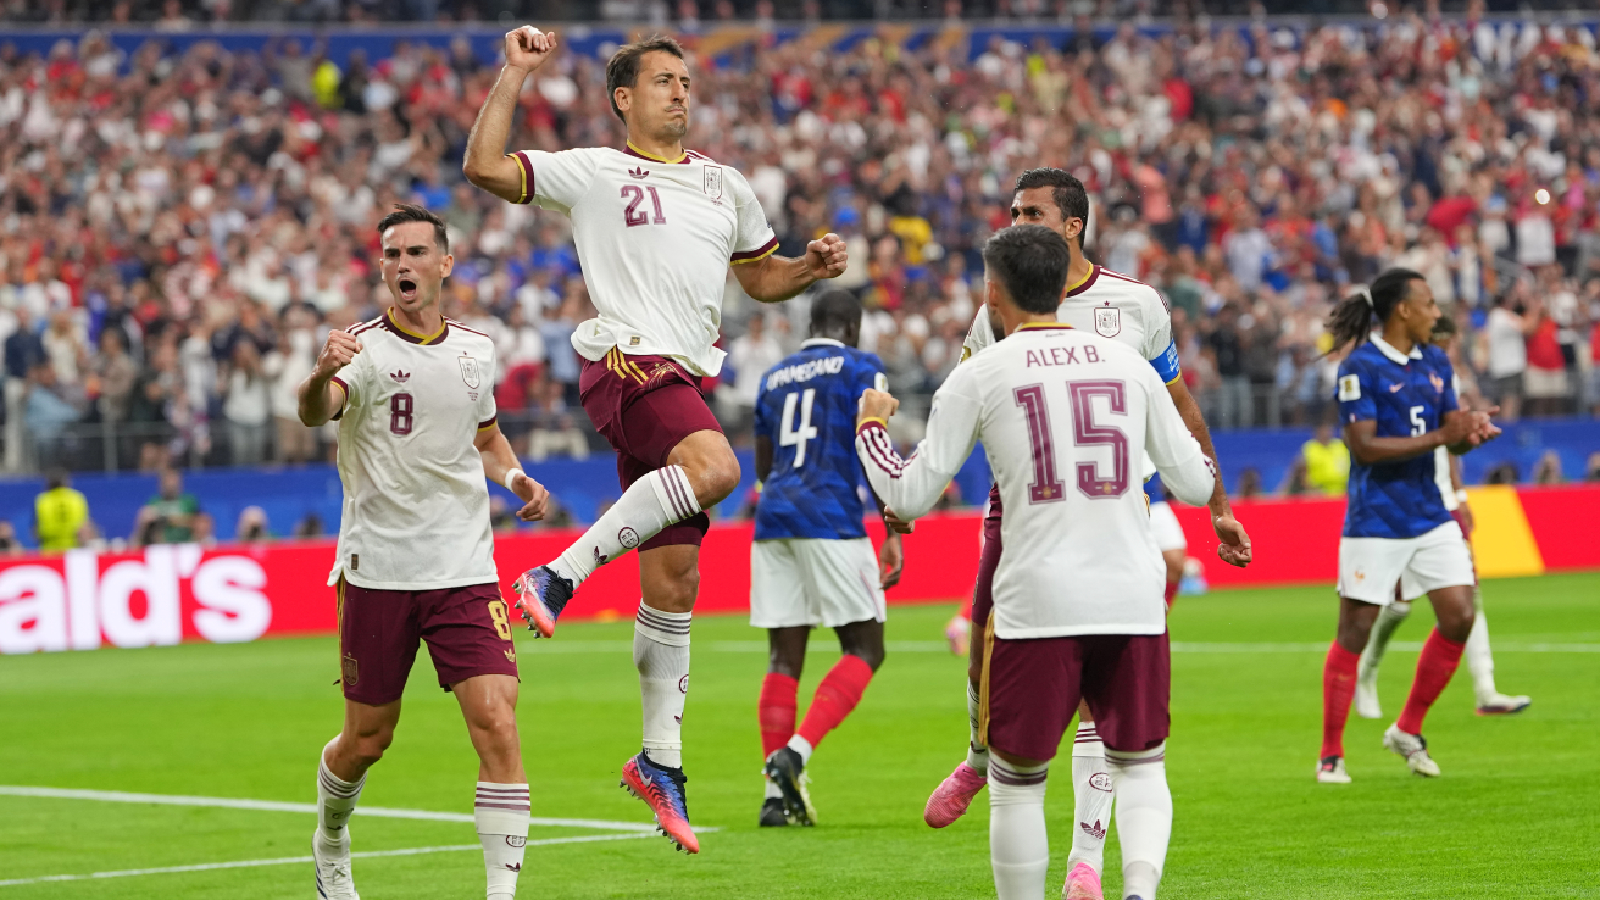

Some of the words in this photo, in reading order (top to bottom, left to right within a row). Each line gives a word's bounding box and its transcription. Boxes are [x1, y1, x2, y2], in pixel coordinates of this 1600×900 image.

[620, 185, 667, 227] 21
[1026, 345, 1080, 367] ALEX
[1083, 344, 1106, 363] B.
[389, 393, 413, 435] 8
[779, 388, 817, 468] 4
[1410, 405, 1426, 438] 5
[1012, 378, 1131, 505] 15
[0, 543, 272, 654] ald's
[487, 600, 511, 640] 8
